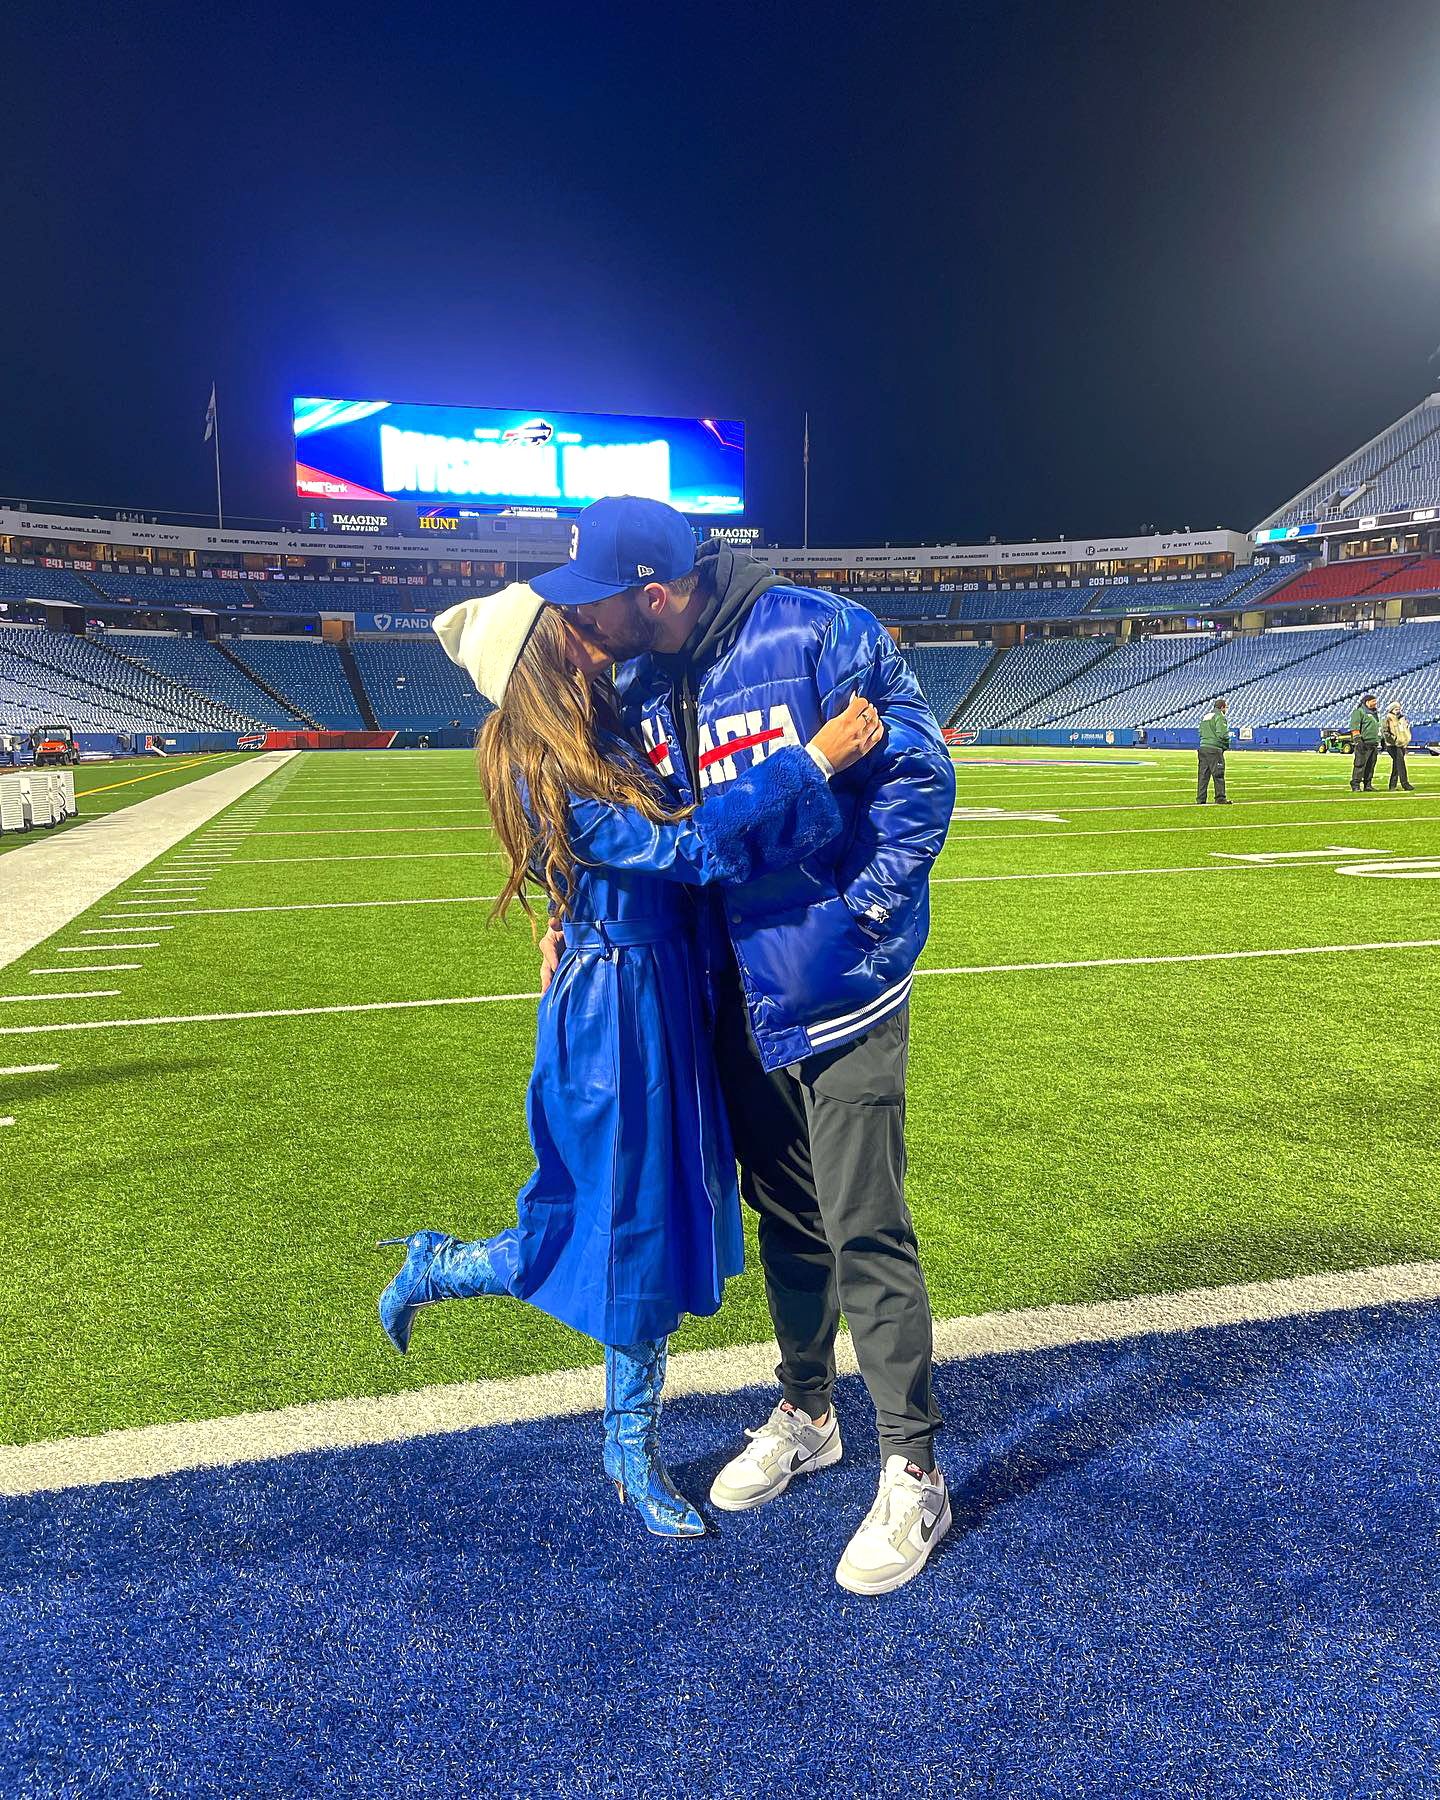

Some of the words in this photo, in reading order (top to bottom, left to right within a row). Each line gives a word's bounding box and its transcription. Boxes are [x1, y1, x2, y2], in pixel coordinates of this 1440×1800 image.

[332, 515, 388, 526] IMAGINE
[419, 517, 459, 530] HUNT
[710, 528, 760, 538] IMAGINE
[46, 559, 63, 568] 241
[74, 560, 92, 570] 242
[1280, 555, 1296, 564] 205
[221, 570, 239, 579] 242
[248, 571, 265, 580] 243
[381, 576, 398, 585] 243
[407, 577, 424, 585] 244
[1089, 578, 1104, 586] 203
[1113, 577, 1129, 585] 204
[963, 583, 979, 591] 203
[395, 618, 434, 629] FAND
